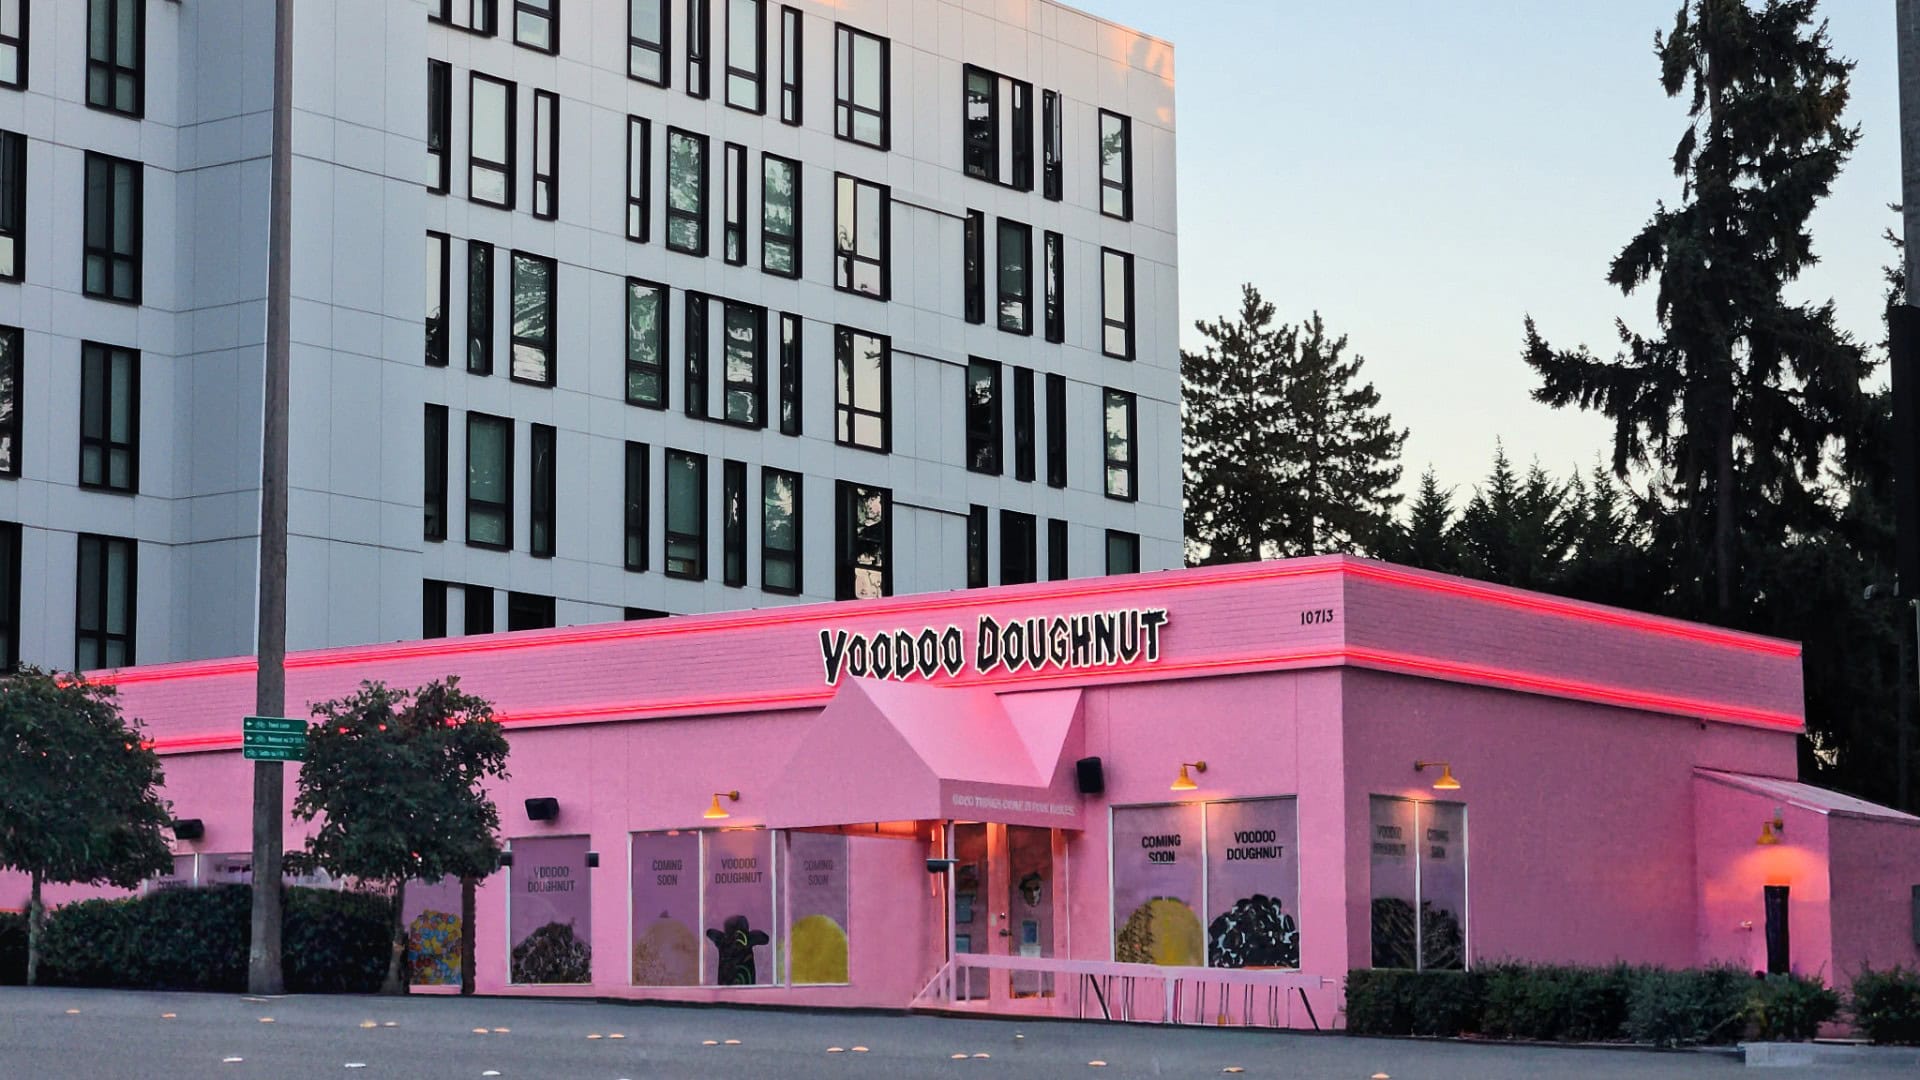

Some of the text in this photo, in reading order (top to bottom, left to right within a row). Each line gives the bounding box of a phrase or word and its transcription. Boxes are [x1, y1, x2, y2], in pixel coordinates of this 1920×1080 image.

[1301, 609, 1333, 625] 10713
[819, 609, 1170, 686] VOODOO DOUGHNUT
[1142, 834, 1181, 848] COMING
[1234, 830, 1276, 844] VOODOO
[1148, 851, 1175, 863] SOON
[1227, 846, 1283, 861] DOUGHNUT
[652, 859, 682, 871] COMING
[720, 858, 757, 870] VOODOO
[803, 859, 833, 871] COMING
[534, 866, 570, 878] VOODOO
[715, 872, 763, 884] DOUGHNUT
[657, 874, 678, 886] SOON
[808, 874, 829, 886] SOON
[527, 880, 575, 893] DOUGHNUT
